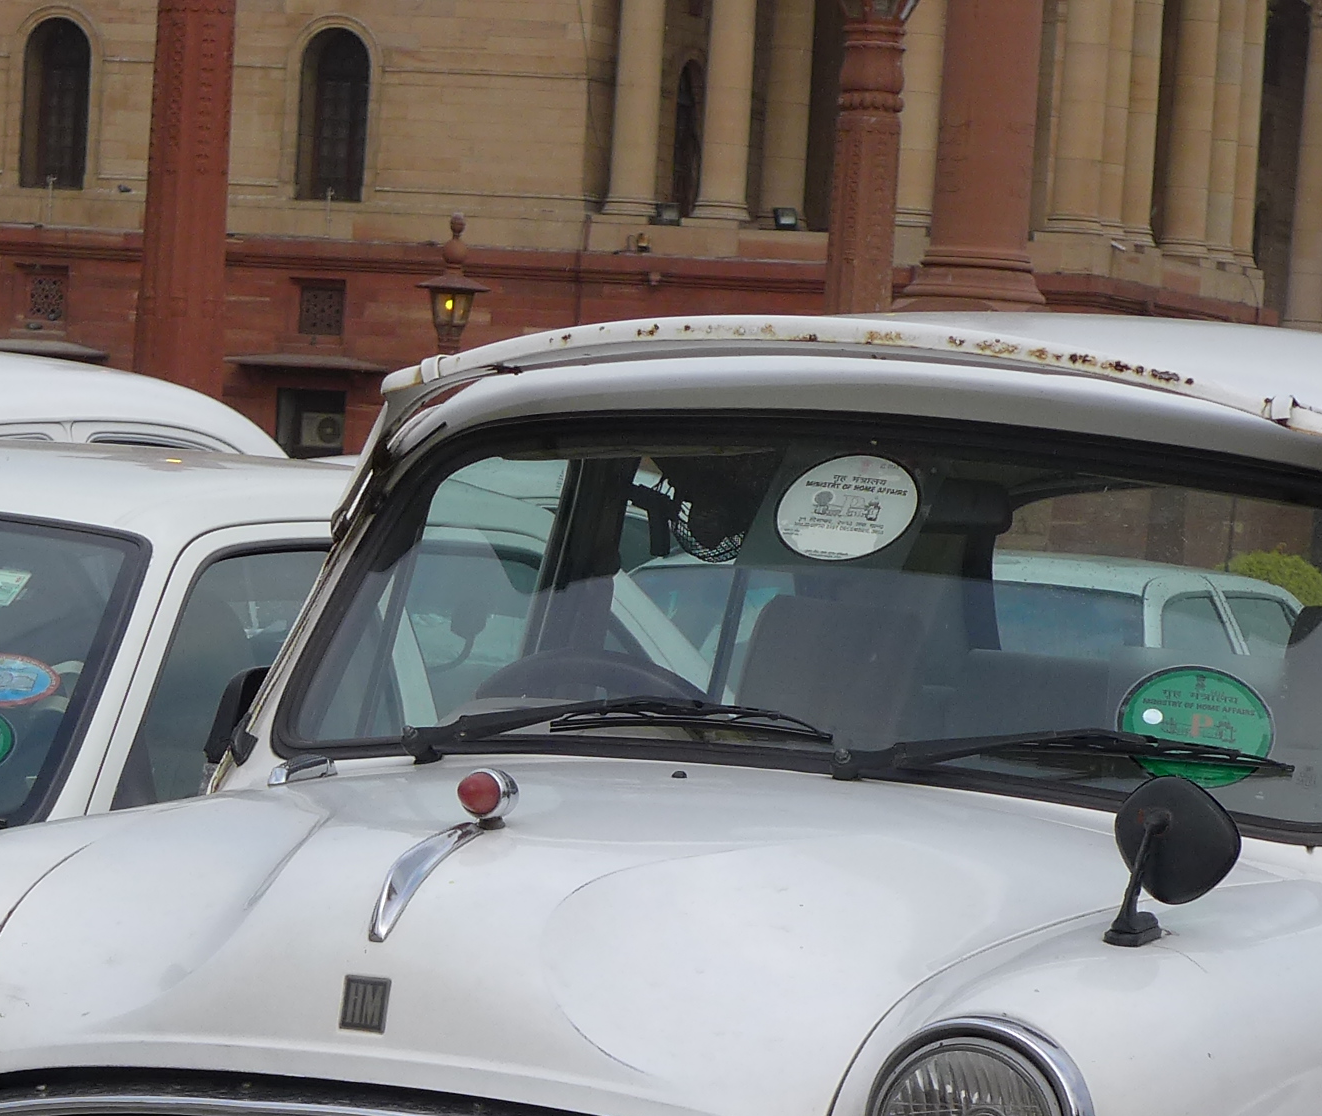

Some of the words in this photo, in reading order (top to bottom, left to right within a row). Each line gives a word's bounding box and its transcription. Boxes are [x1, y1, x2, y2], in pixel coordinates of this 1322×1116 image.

[853, 485, 876, 493] HOME
[877, 487, 908, 497] AFFAIRS
[1142, 698, 1184, 708] MINISTRY
[1196, 703, 1220, 712] HOME
[1222, 706, 1256, 716] AFFAIRS
